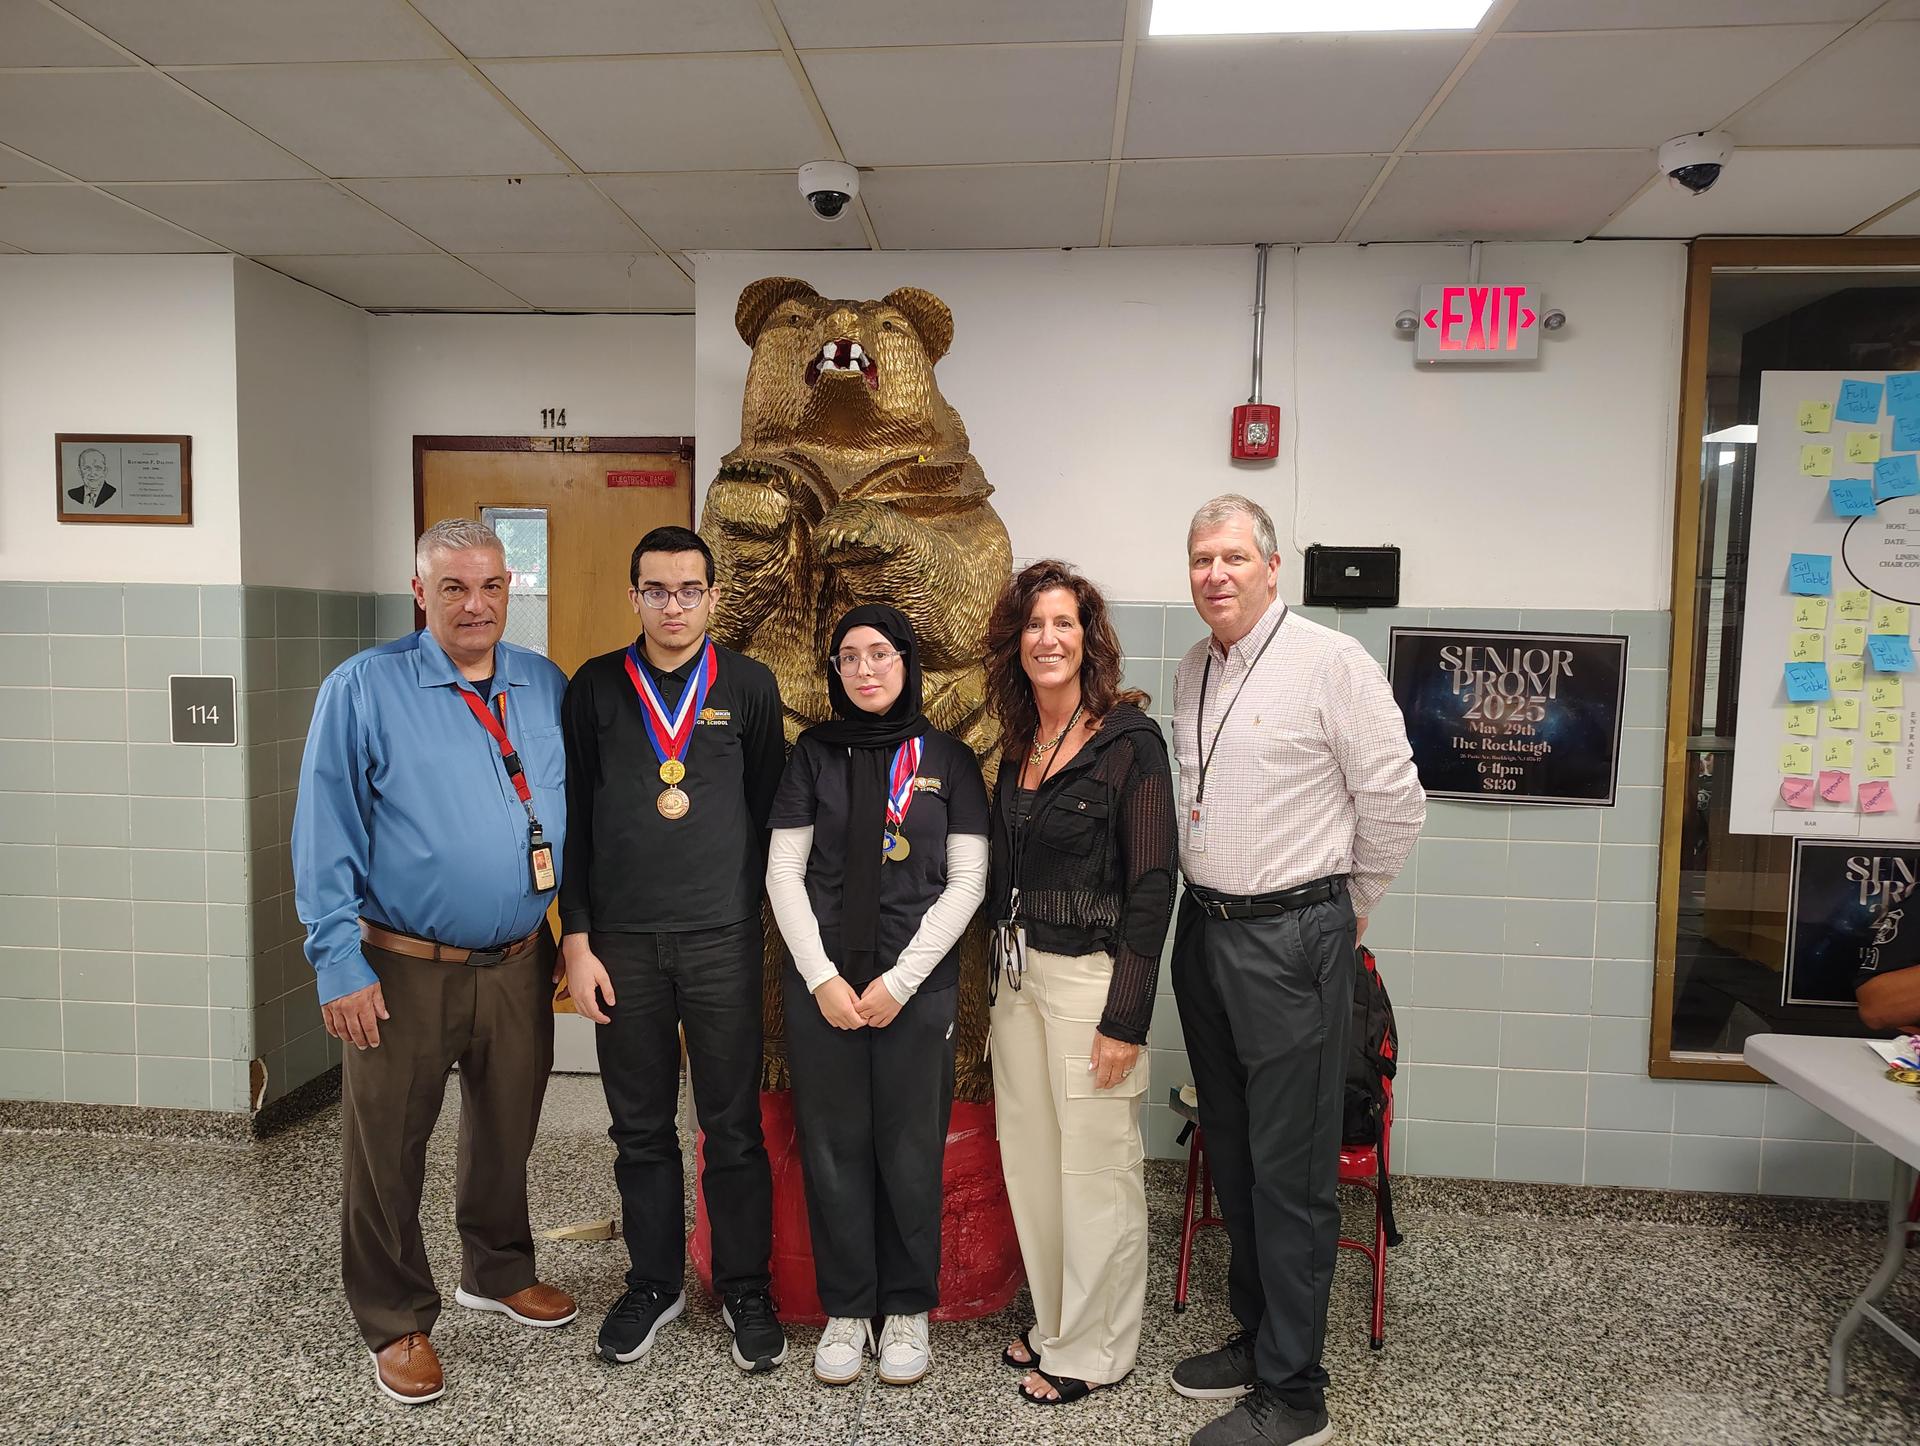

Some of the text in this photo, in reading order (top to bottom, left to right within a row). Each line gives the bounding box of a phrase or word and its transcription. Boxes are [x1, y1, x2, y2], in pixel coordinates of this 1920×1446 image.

[1439, 287, 1526, 351] EXIT
[1845, 384, 1868, 399] Full
[1844, 401, 1877, 413] Table
[540, 408, 567, 429] 114
[550, 437, 575, 452] 114
[1875, 460, 1901, 479] Full
[1880, 476, 1916, 490] Table
[1832, 488, 1853, 498] Full
[1840, 496, 1877, 511] Table!
[1792, 561, 1811, 573] Full
[1794, 572, 1830, 585] Table!
[1870, 640, 1892, 653] Full
[1439, 645, 1574, 677] SENIOR
[1789, 668, 1815, 681] Full
[1452, 669, 1559, 700] PROM
[1799, 679, 1828, 693] Table!
[186, 704, 219, 724] 114
[1462, 692, 1547, 722] 2025
[1468, 721, 1536, 738] May 29th
[1452, 736, 1552, 757] The Rockleigh
[1906, 711, 1917, 770] ENTRANCE
[1477, 761, 1524, 778] 6-11pm
[1483, 778, 1517, 791] $130
